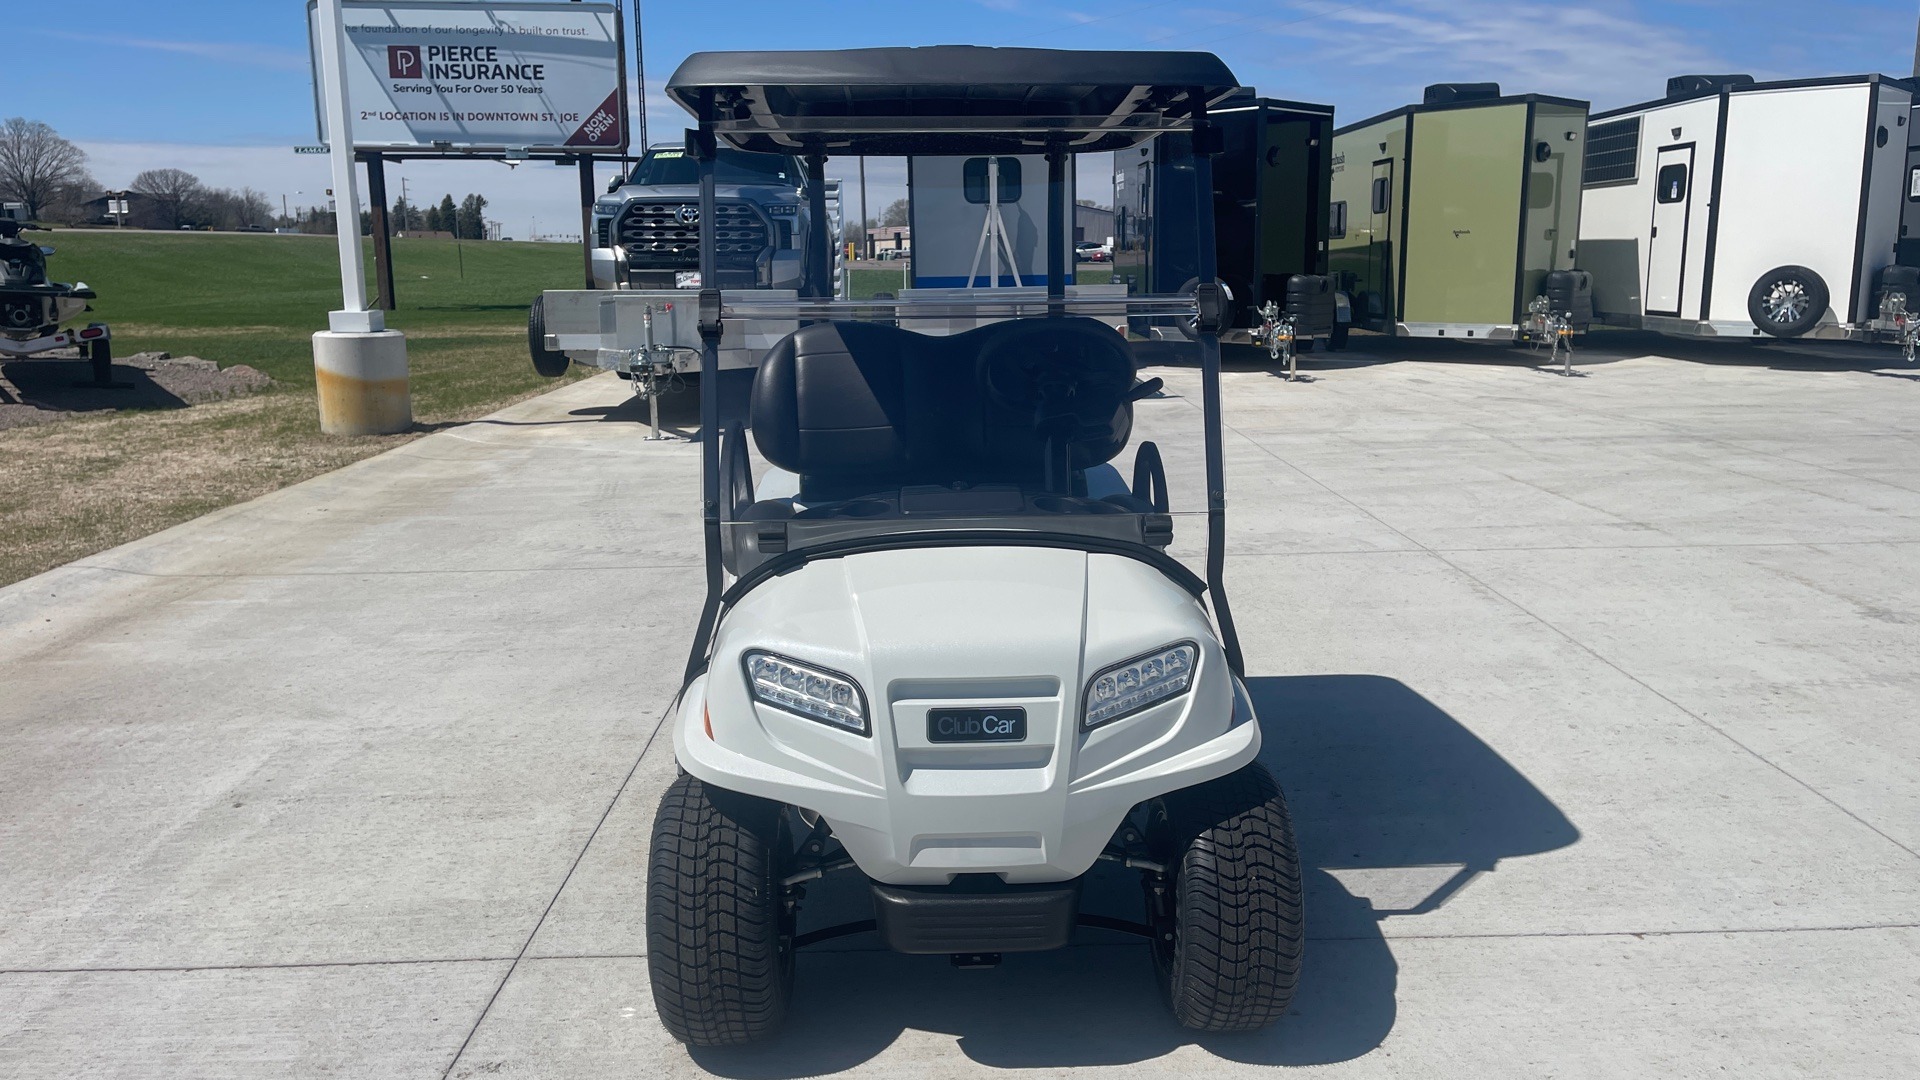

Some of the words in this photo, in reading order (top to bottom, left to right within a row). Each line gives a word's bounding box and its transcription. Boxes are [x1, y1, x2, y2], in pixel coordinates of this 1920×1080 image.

[343, 24, 358, 33] he
[361, 24, 417, 33] foundation
[421, 24, 432, 34] of
[456, 25, 503, 36] longevity
[507, 25, 516, 34] is
[519, 26, 542, 35] built
[562, 27, 589, 36] trust.
[428, 45, 498, 62] PIERCE
[430, 64, 545, 80] INSURANCE
[393, 84, 432, 94] Serving
[435, 84, 453, 93] You
[456, 84, 472, 93] For
[473, 84, 498, 93] Over
[501, 85, 513, 94] 50
[516, 84, 543, 94] Years
[360, 111, 376, 120] 2nd
[379, 112, 436, 120] LOCATION
[440, 112, 449, 121] IS
[453, 112, 464, 121] IN
[468, 112, 538, 122] DOWNTOWN
[542, 113, 557, 122] ST.
[560, 113, 579, 123] JOE
[583, 109, 606, 134] NOW
[588, 113, 616, 142] OPEN!
[937, 717, 980, 735] Club
[982, 715, 1016, 734] Car
